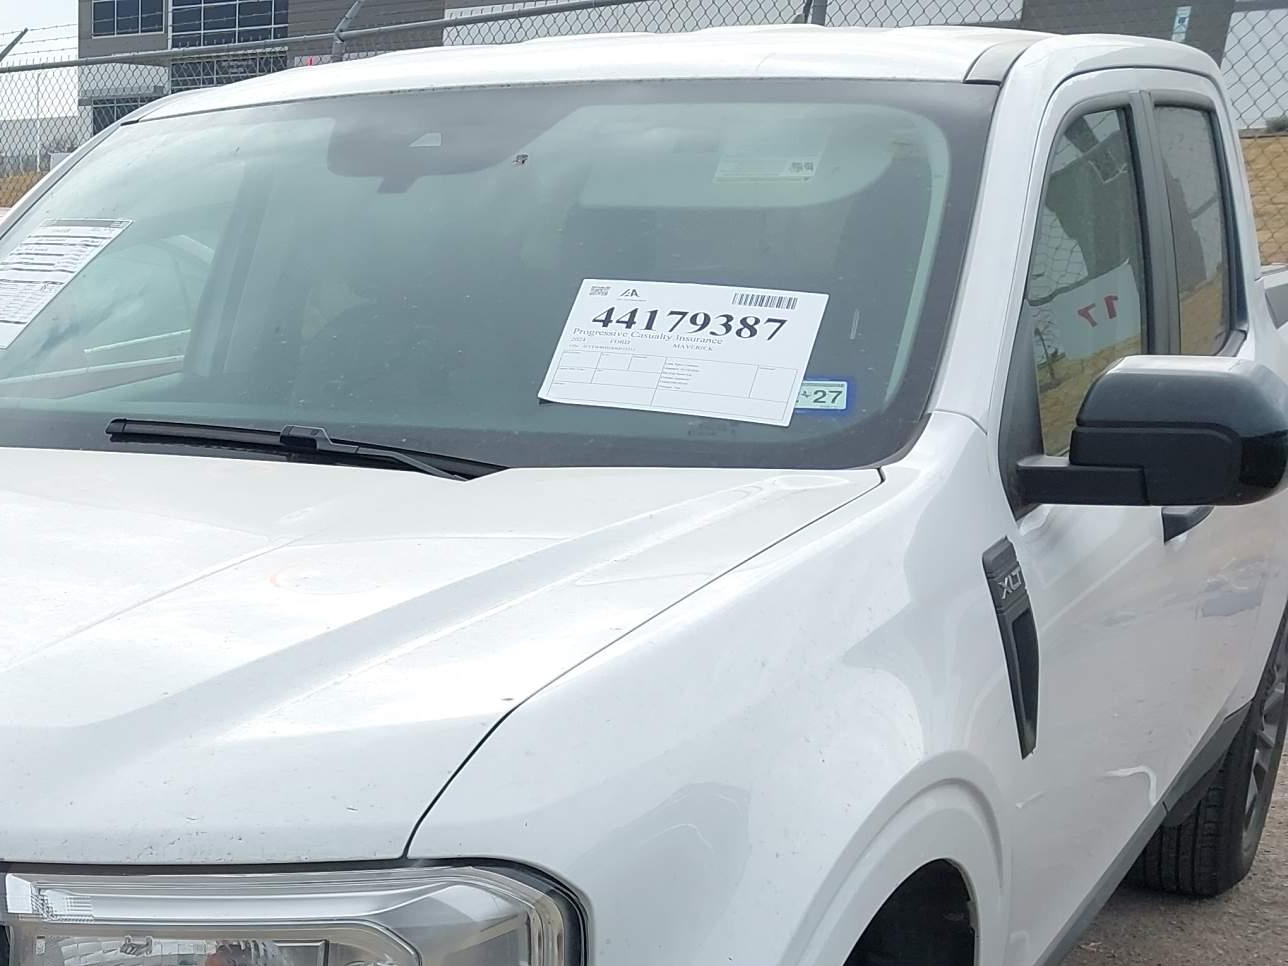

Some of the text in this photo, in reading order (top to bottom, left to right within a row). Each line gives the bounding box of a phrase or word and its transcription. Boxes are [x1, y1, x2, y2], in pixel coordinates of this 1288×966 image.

[591, 306, 788, 342] 44179387
[573, 327, 724, 345] Progressive Casualty Insurance
[672, 343, 714, 352] MAVERICK
[813, 390, 843, 404] 27
